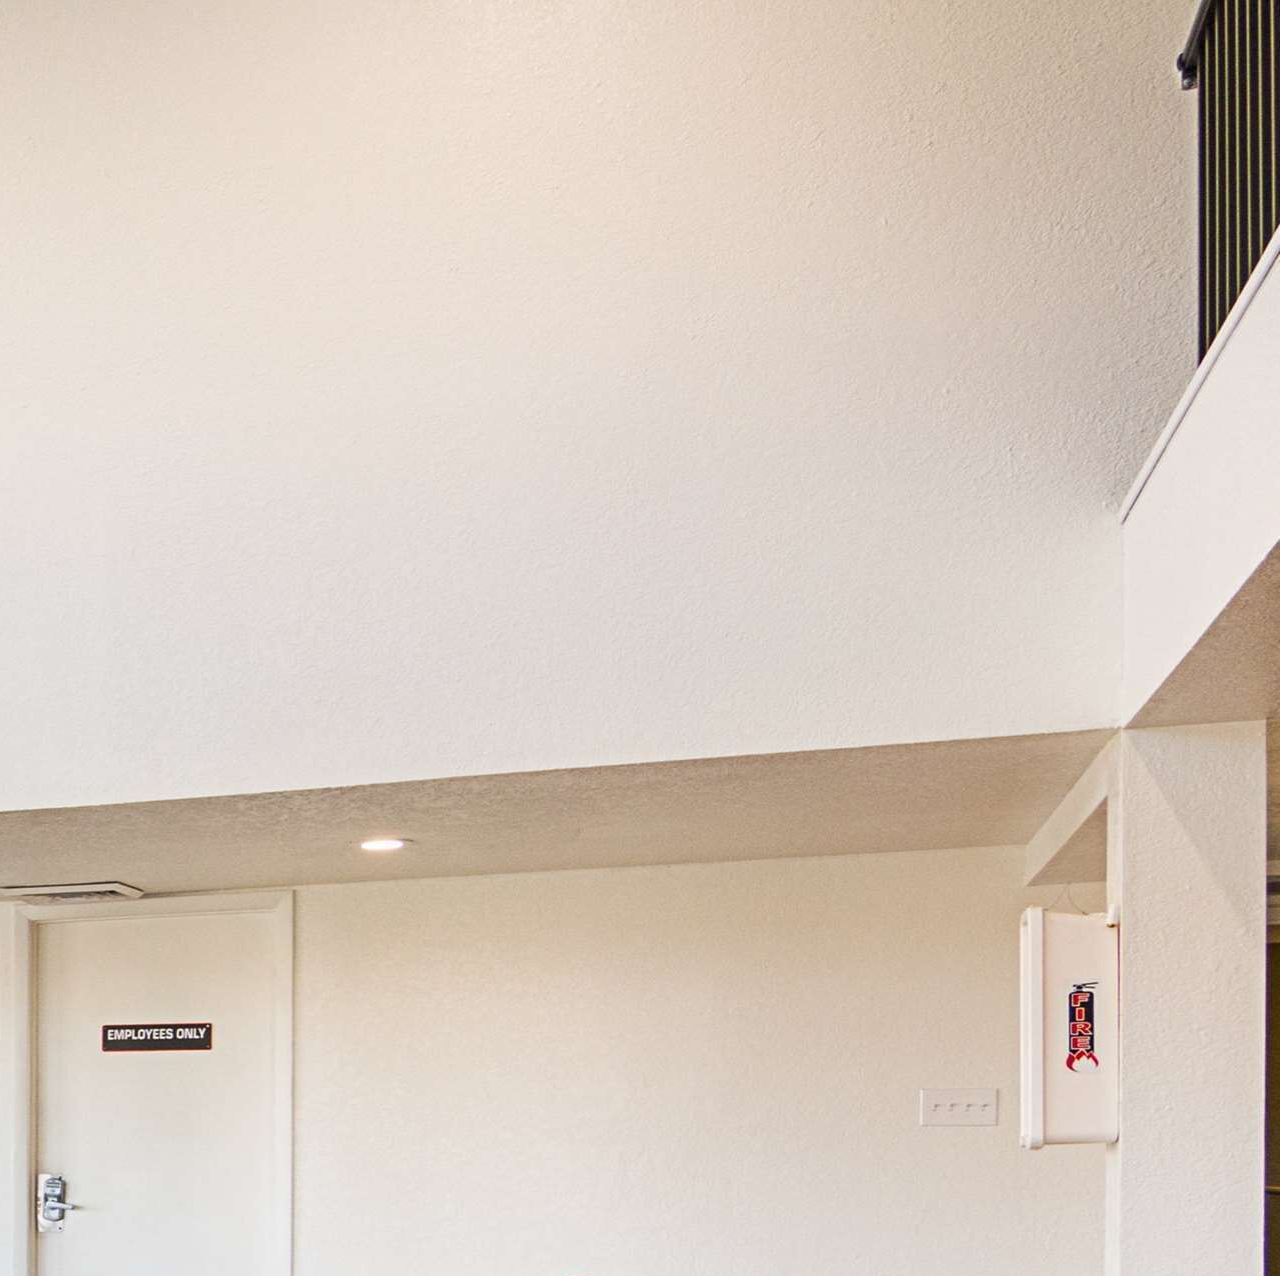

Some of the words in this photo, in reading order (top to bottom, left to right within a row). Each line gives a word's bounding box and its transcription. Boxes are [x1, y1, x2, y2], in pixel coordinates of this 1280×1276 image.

[107, 1028, 174, 1040] EMPLOYEES
[176, 1027, 206, 1039] ONLY
[1070, 993, 1092, 1049] FIRE
